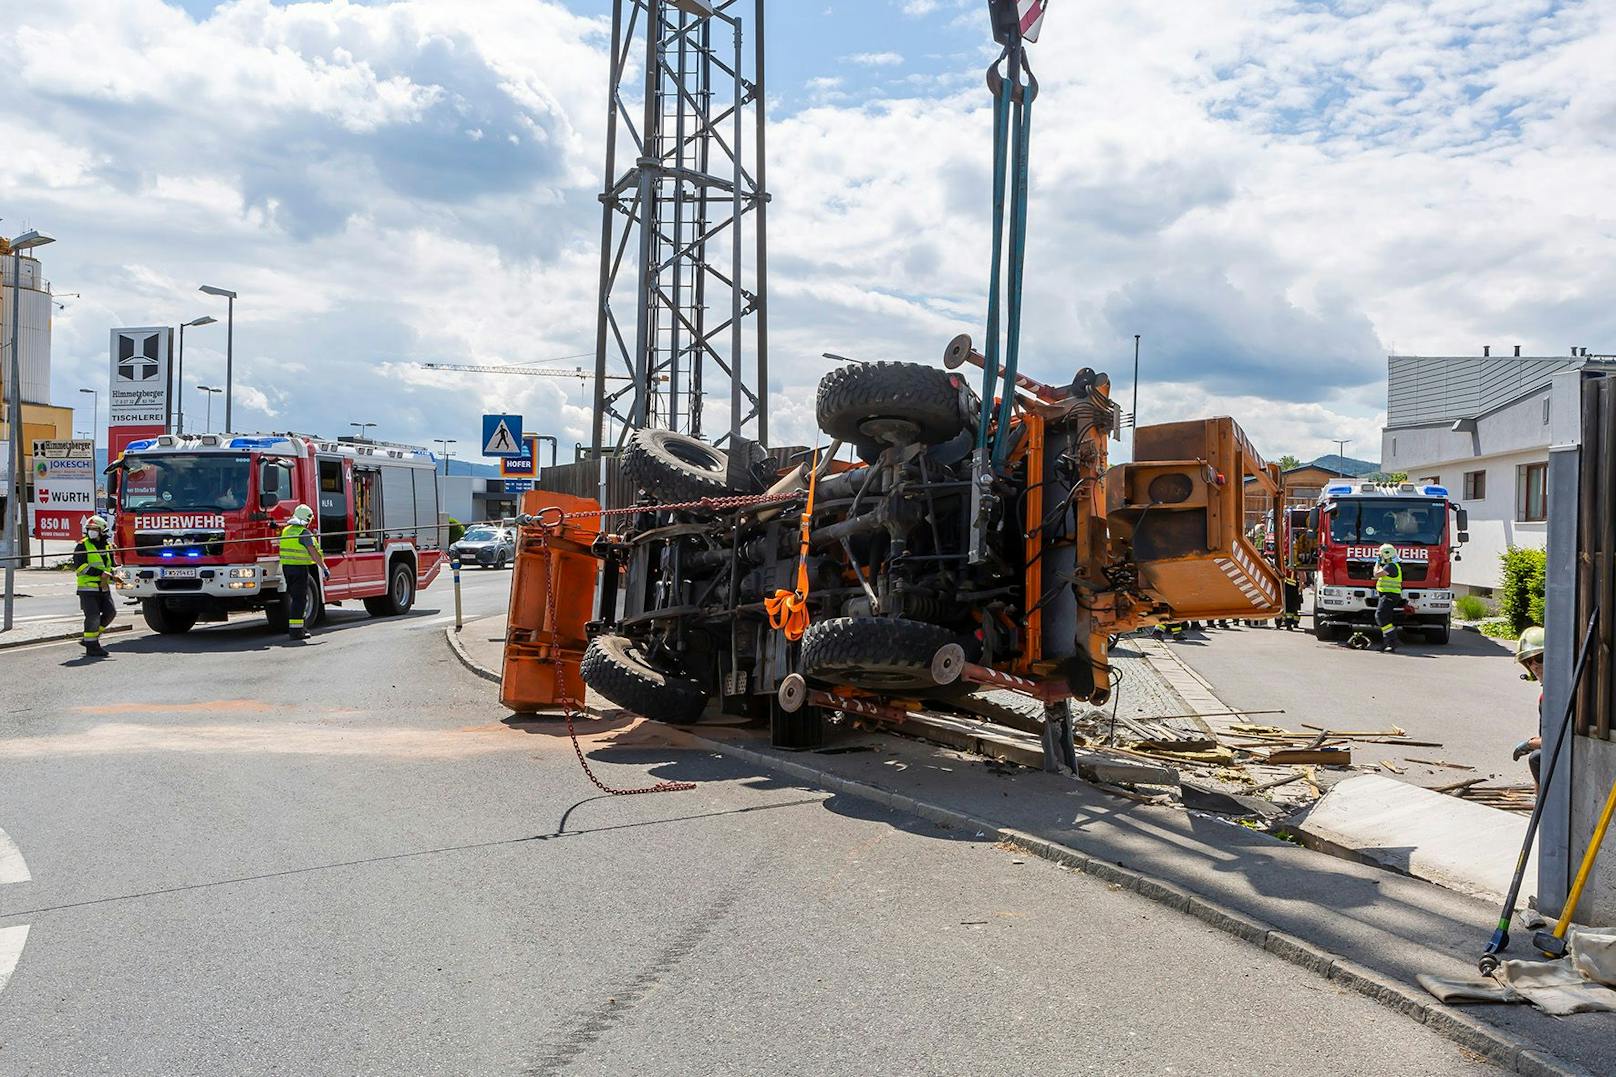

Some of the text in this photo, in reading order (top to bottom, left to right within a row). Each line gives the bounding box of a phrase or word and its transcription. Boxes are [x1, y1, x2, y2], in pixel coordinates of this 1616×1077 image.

[112, 390, 164, 399] Himmetzberger
[50, 460, 90, 468] JOKESCH
[506, 460, 531, 468] HOFER
[345, 467, 352, 483] 4
[51, 491, 90, 503] WÜRTH
[40, 518, 70, 530] 850 M
[134, 515, 226, 529] FEUERWEHR
[1346, 547, 1429, 559] FEUEEHR
